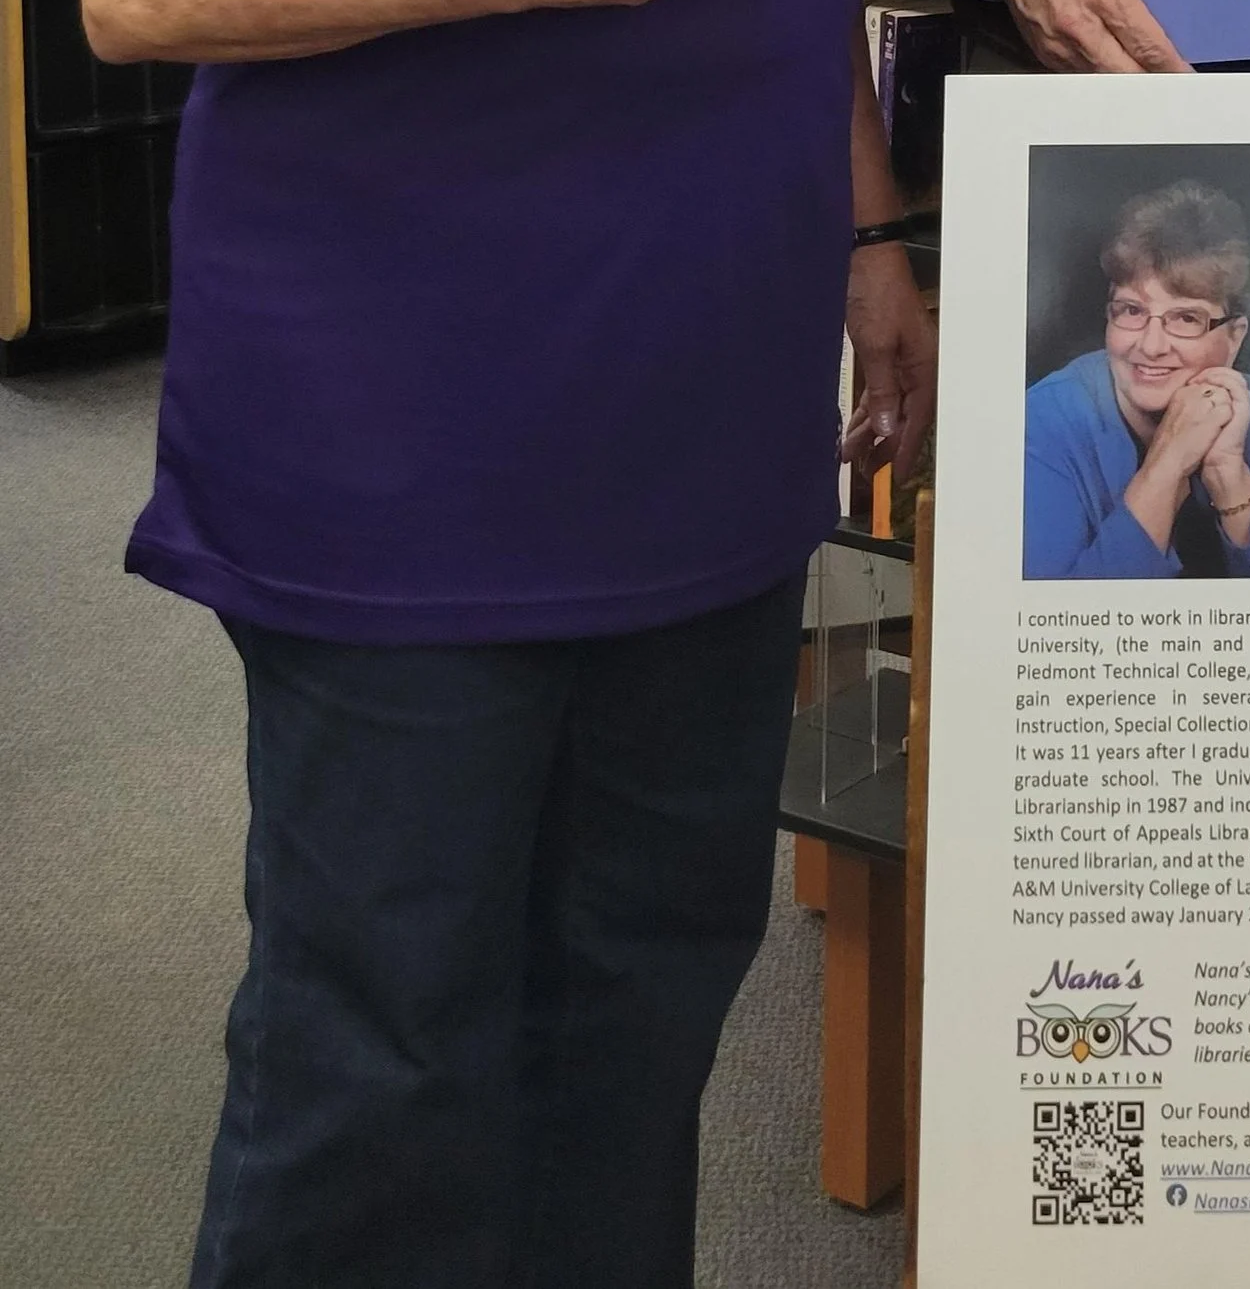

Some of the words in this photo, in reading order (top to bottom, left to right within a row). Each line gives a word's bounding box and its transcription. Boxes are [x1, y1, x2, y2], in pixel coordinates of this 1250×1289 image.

[1016, 1013, 1174, 1063] BOOKS
[1020, 1071, 1164, 1085] FOUNDATION
[1160, 1130, 1238, 1150] teachers,
